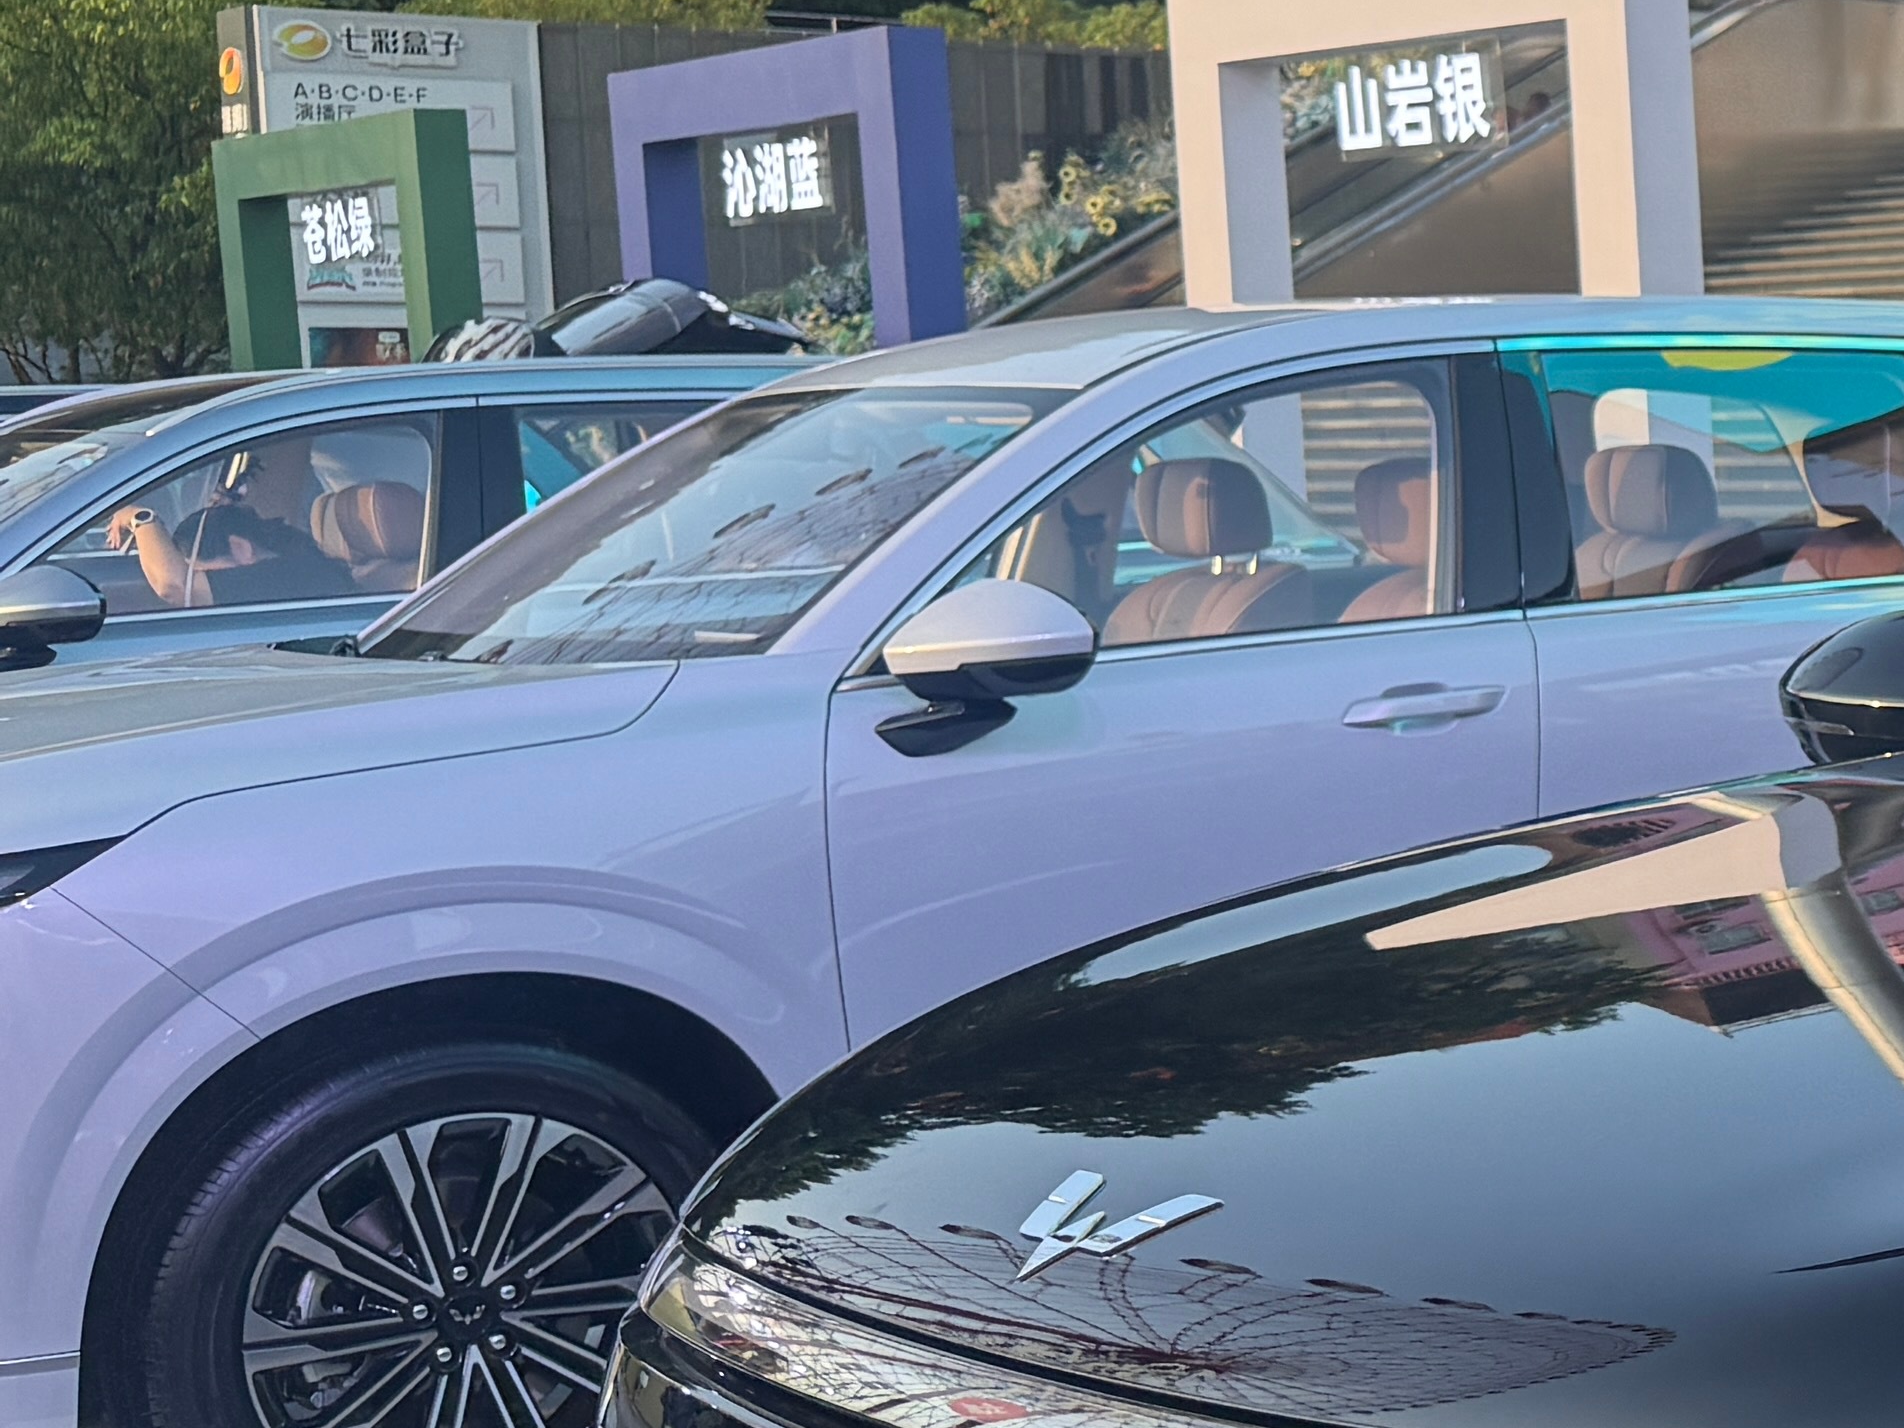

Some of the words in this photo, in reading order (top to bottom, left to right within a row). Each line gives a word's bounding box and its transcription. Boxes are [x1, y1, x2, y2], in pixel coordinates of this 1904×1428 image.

[338, 25, 461, 59] 七彩盒子
[1333, 53, 1492, 152] 山岩银
[721, 136, 824, 219] 沁湖蓝
[300, 195, 376, 265] 苍松绿
